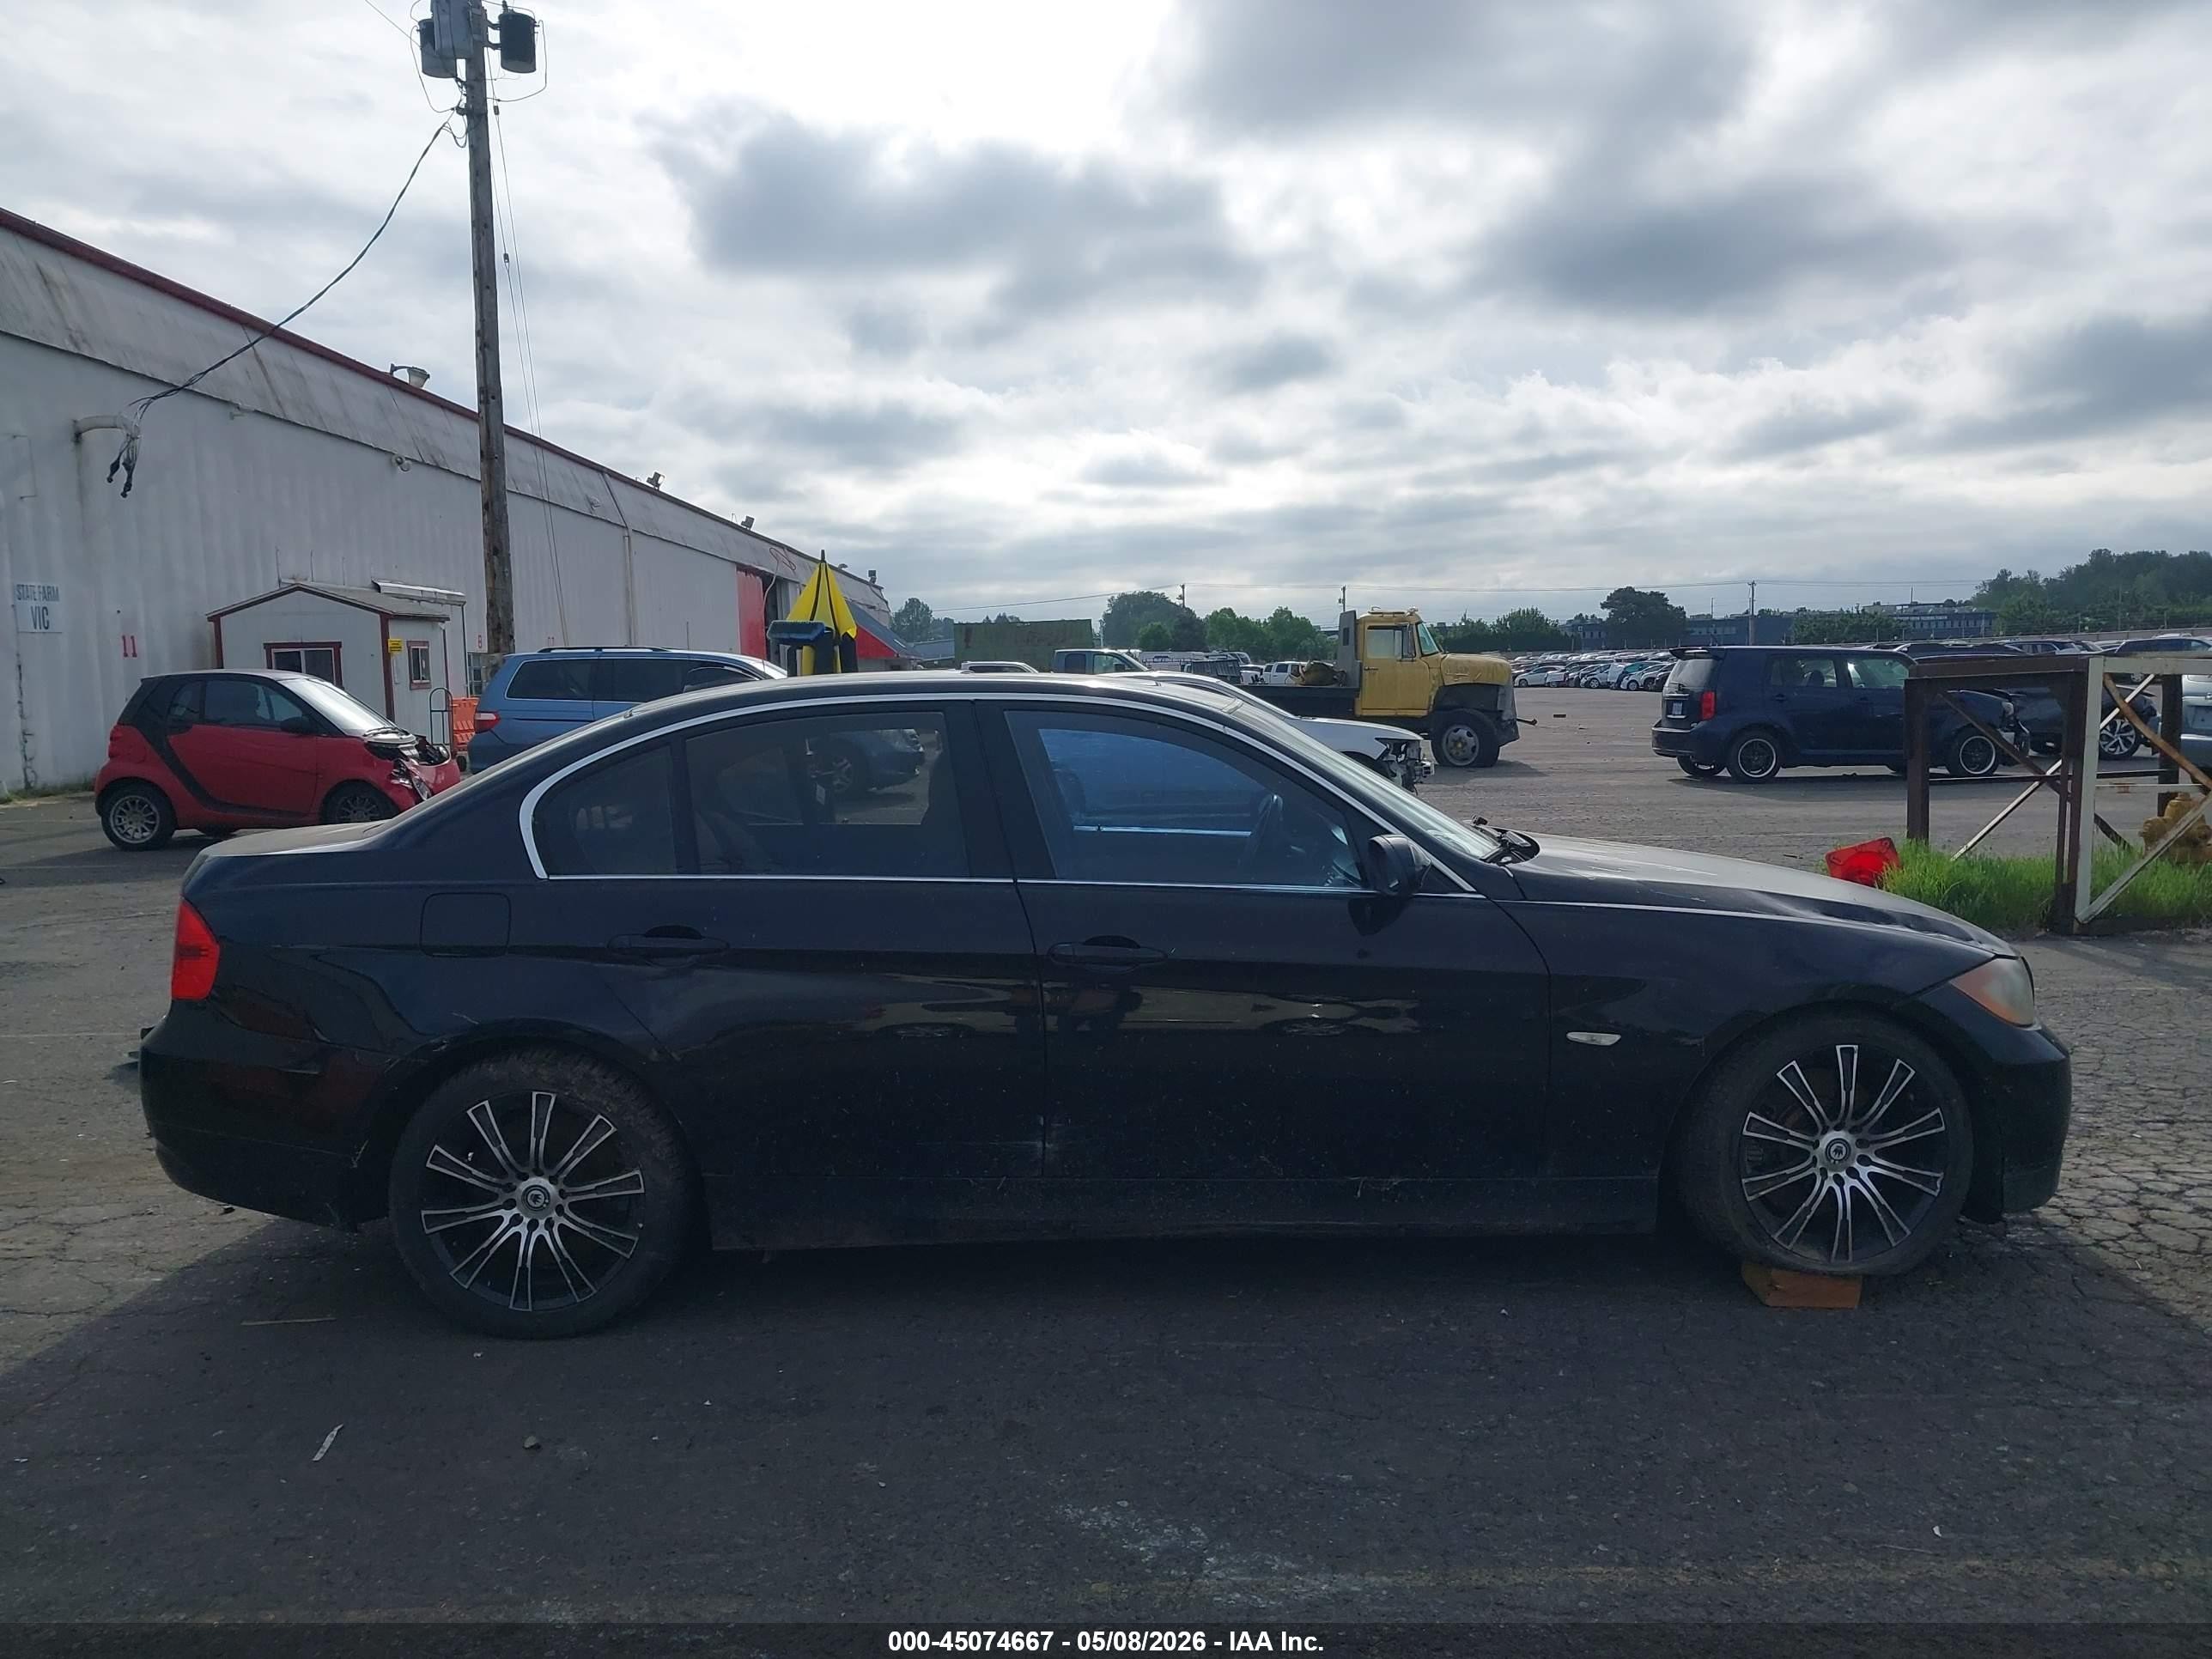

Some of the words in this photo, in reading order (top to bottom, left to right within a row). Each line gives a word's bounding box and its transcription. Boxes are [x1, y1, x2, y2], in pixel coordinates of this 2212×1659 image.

[16, 584, 37, 601] STATE
[38, 585, 60, 601] FARM
[31, 605, 50, 629] VIC
[122, 635, 137, 658] 11
